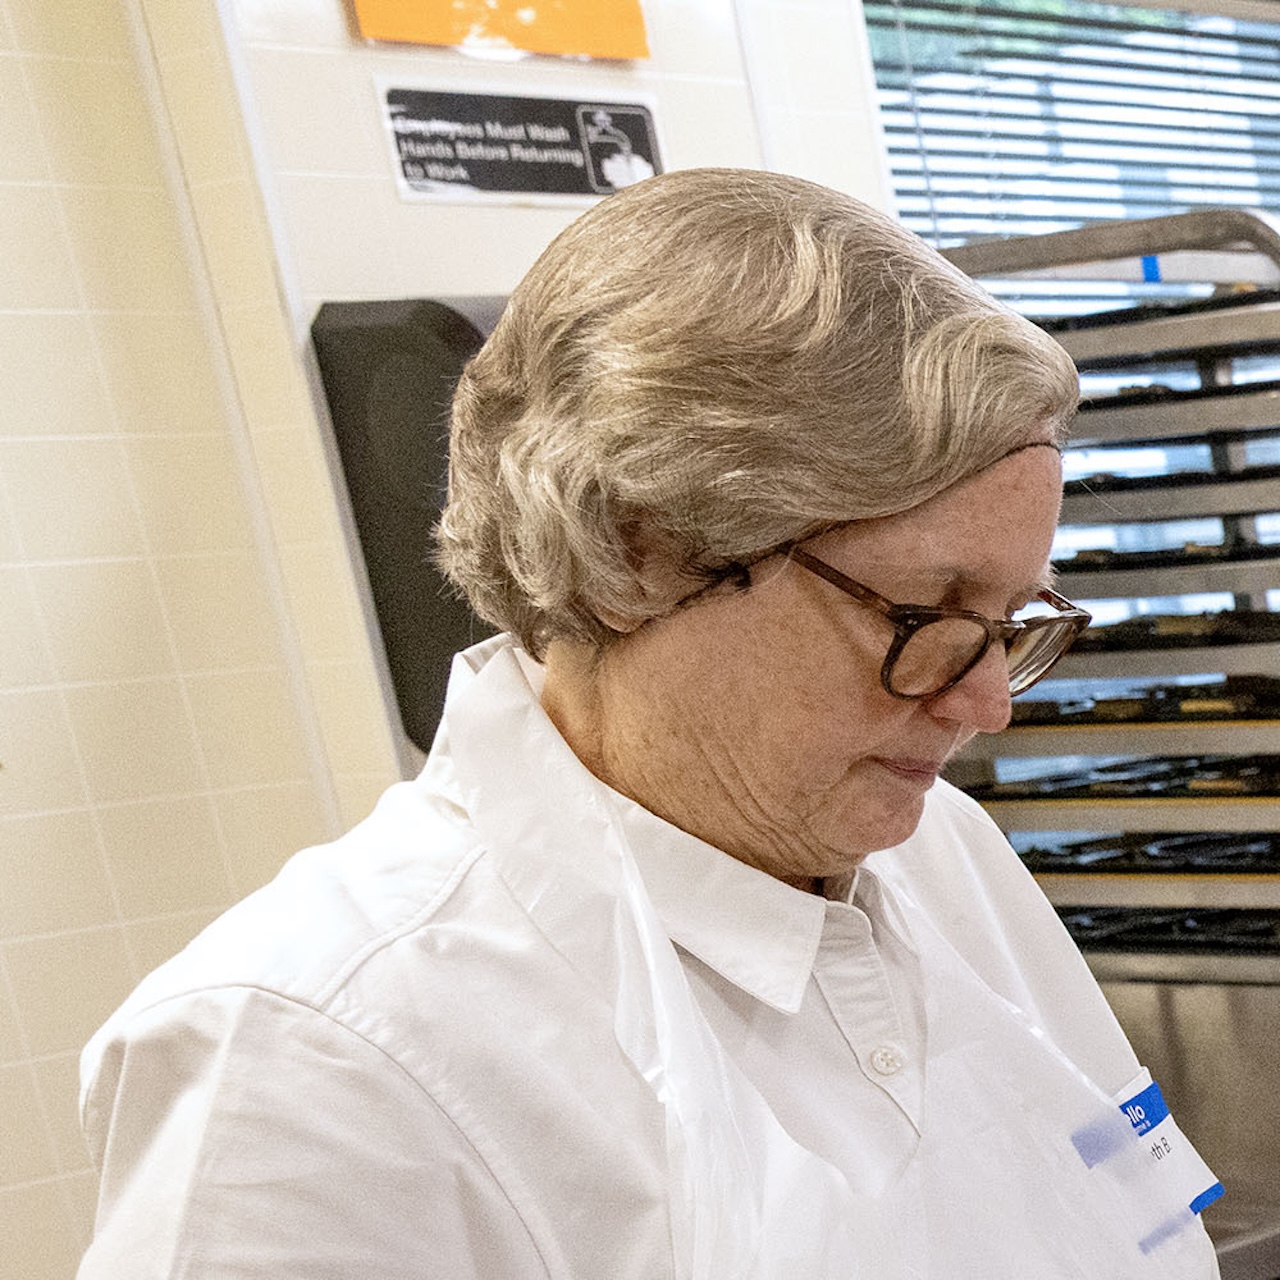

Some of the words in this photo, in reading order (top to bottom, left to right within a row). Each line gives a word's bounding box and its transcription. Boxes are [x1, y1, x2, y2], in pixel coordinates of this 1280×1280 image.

[484, 121, 526, 139] Must
[527, 123, 570, 142] Wash
[400, 139, 454, 158] Hands
[455, 141, 509, 160] Before
[509, 143, 584, 168] Returning
[424, 162, 470, 180] Work
